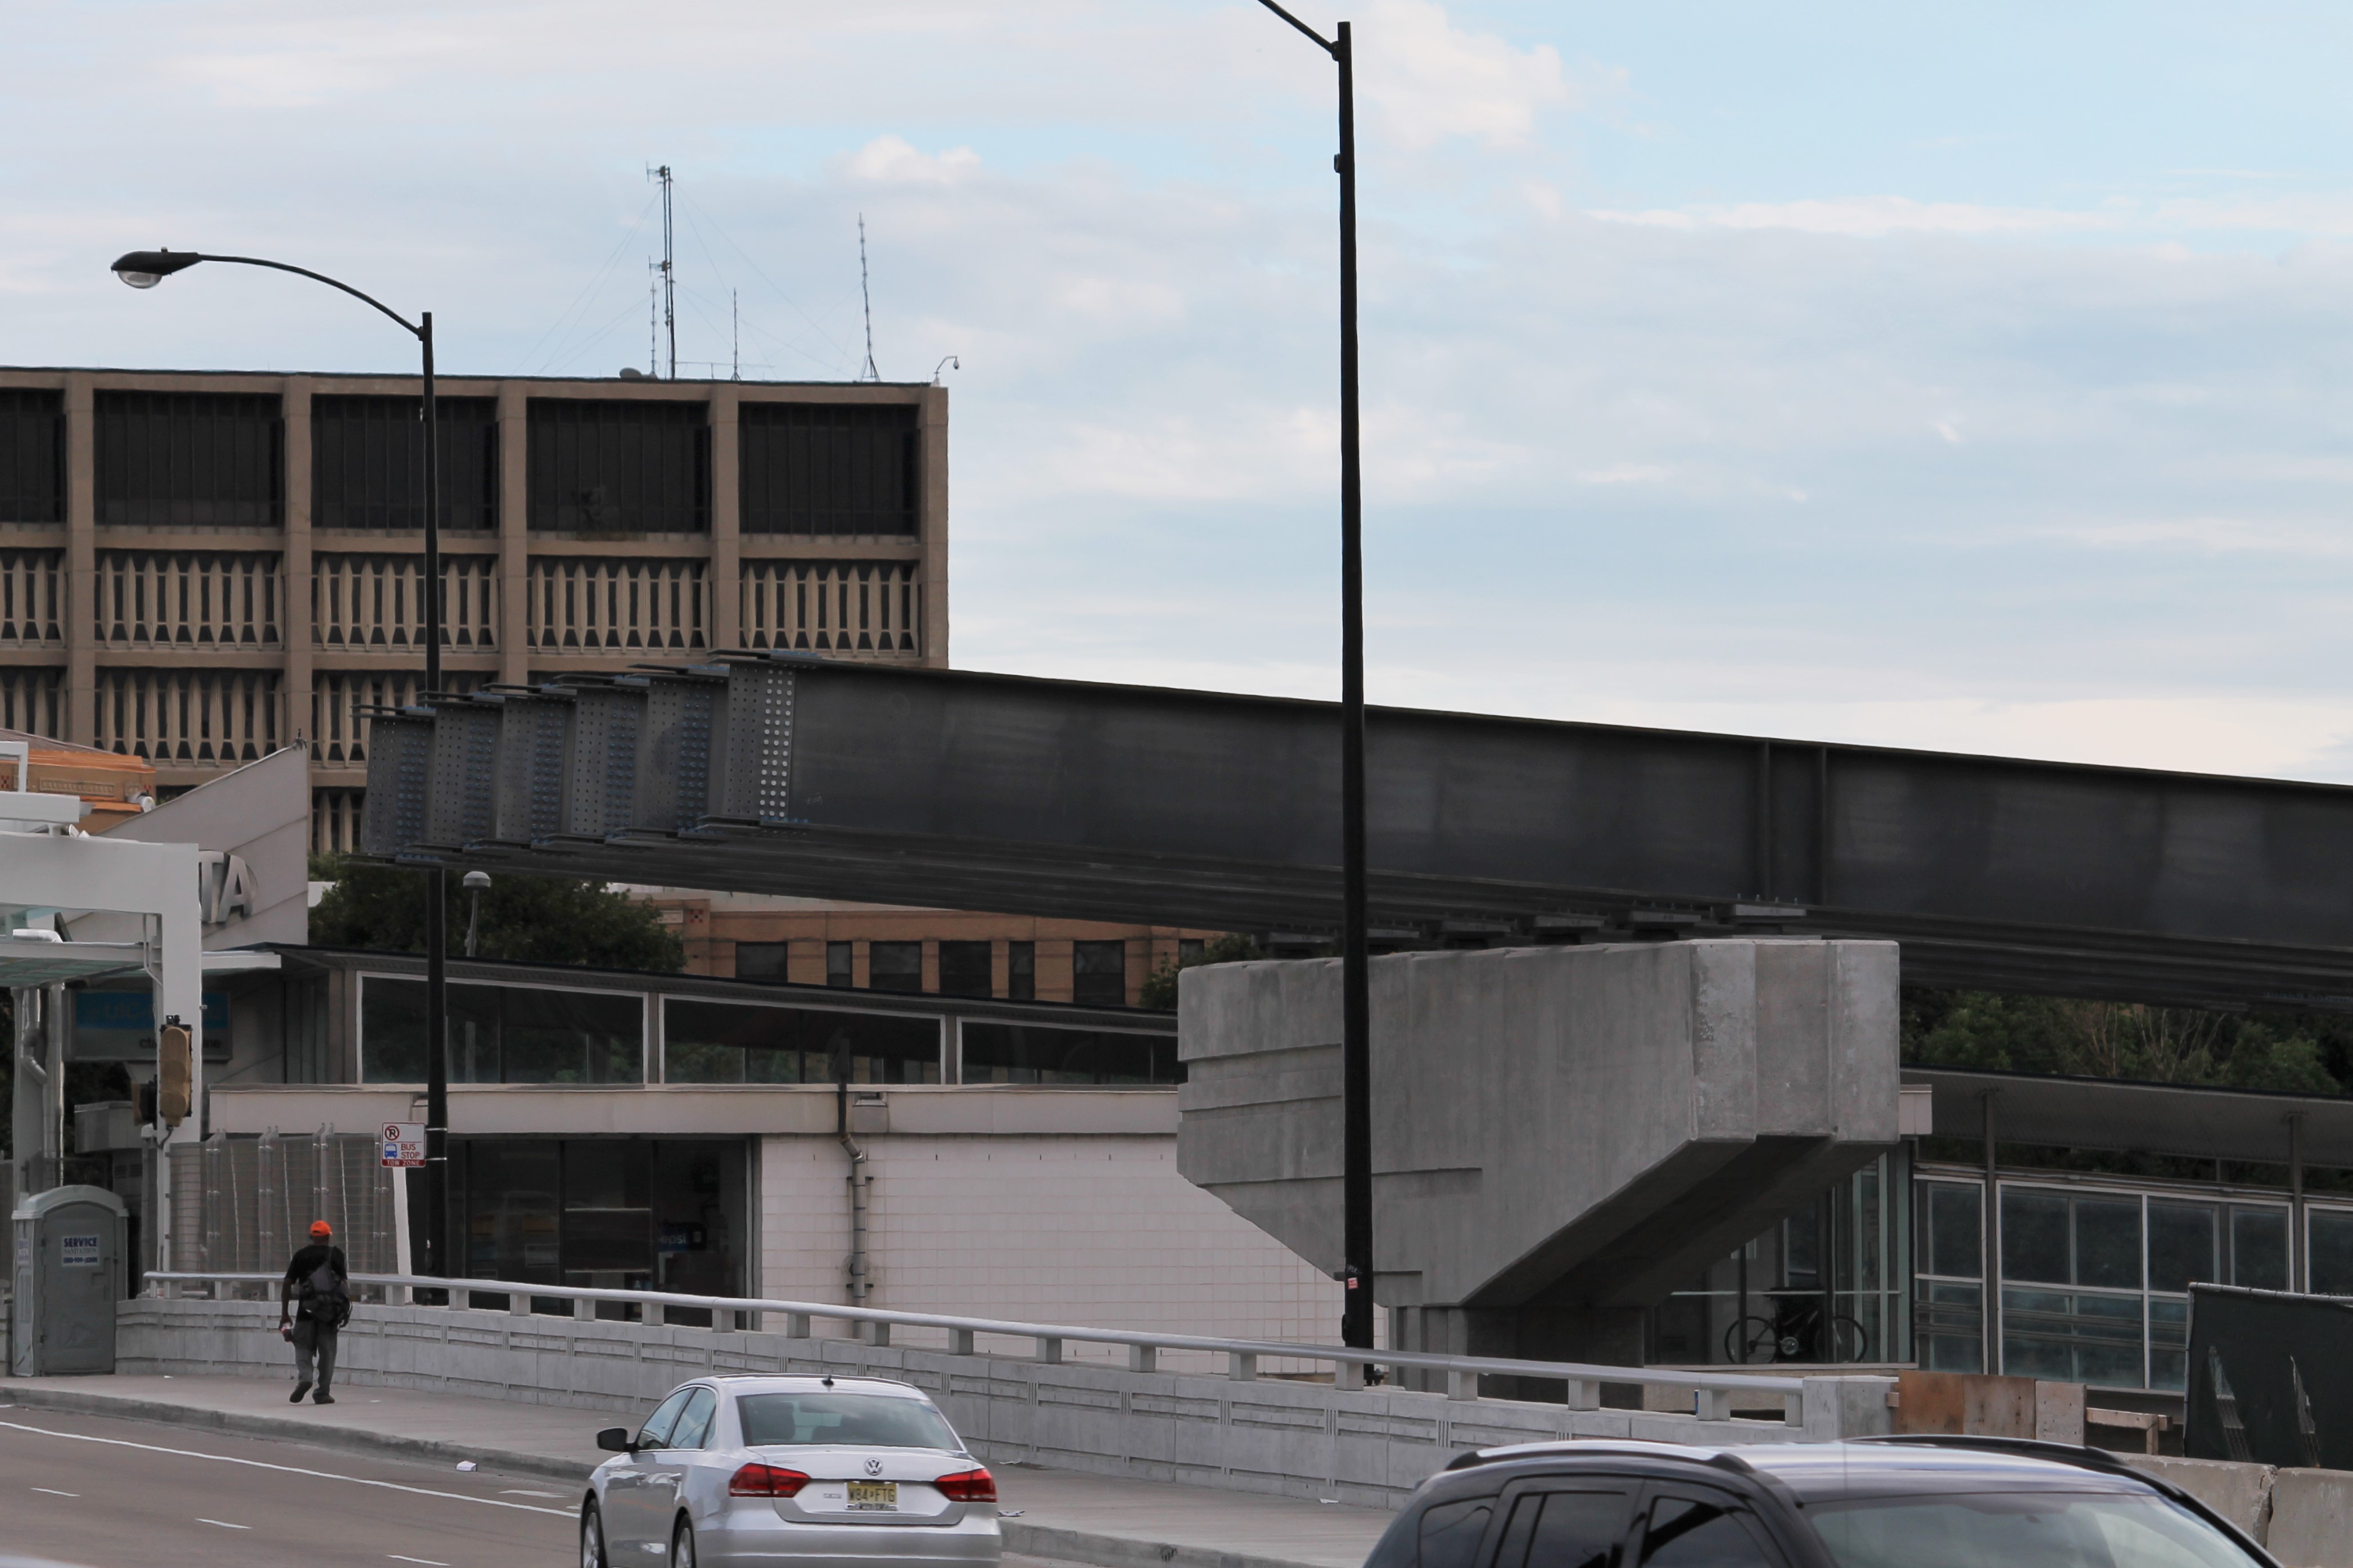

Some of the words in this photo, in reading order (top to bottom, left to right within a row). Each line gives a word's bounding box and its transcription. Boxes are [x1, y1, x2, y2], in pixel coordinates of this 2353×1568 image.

[198, 851, 253, 923] TA
[64, 1237, 97, 1248] SERVICE
[658, 1232, 687, 1246] epsi
